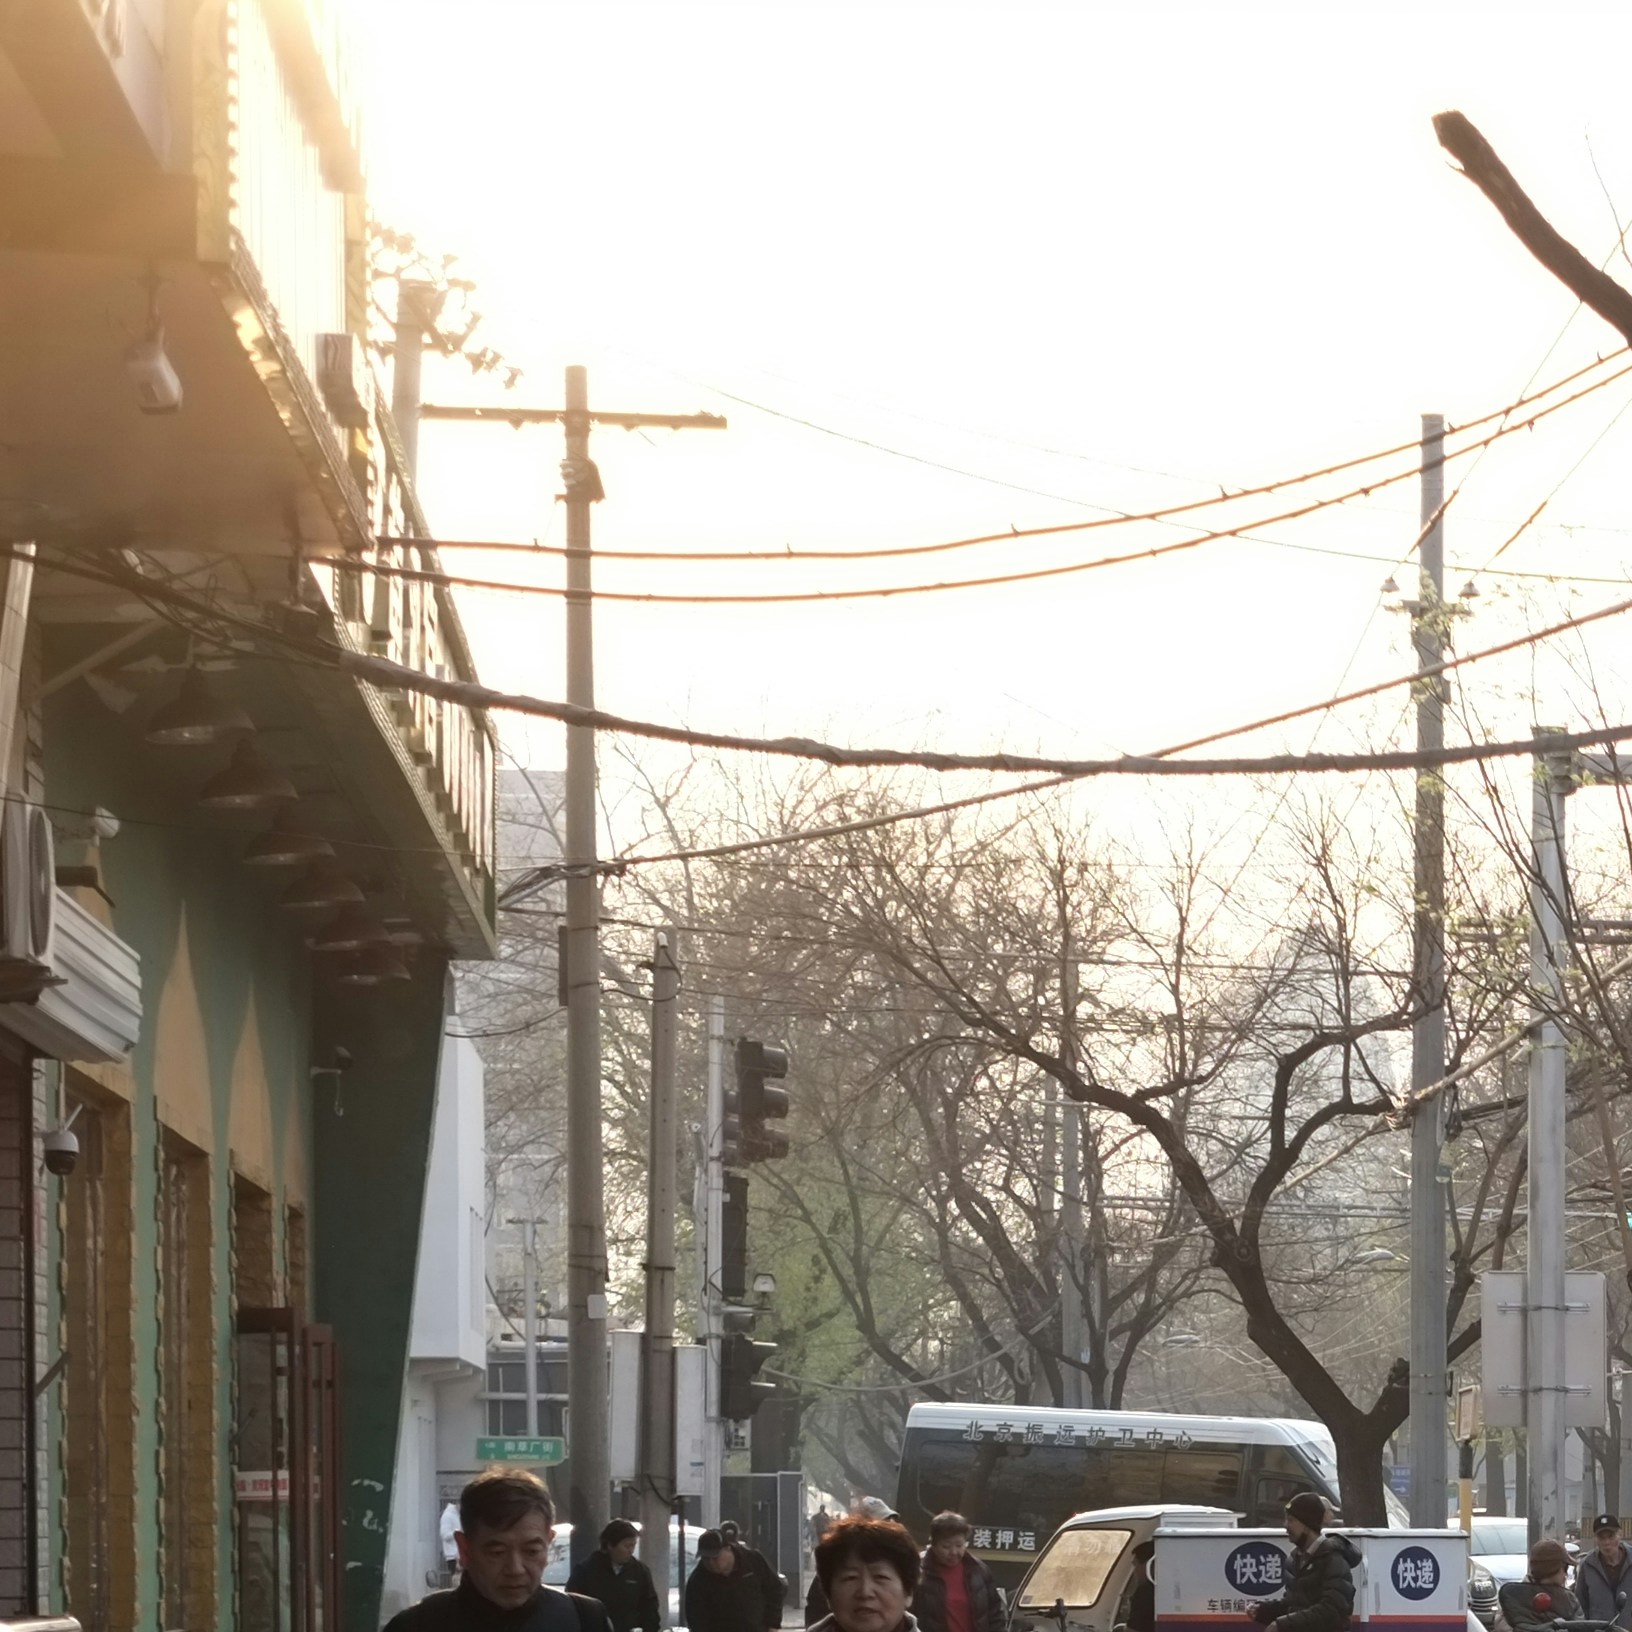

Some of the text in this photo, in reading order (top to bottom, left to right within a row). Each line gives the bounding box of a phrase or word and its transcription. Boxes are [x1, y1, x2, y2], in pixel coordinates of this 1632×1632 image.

[963, 1420, 1193, 1450] 北京振远护卫中心
[973, 1529, 1036, 1551] 装押运
[1233, 1554, 1283, 1585] 快递
[1397, 1558, 1434, 1588] 快递
